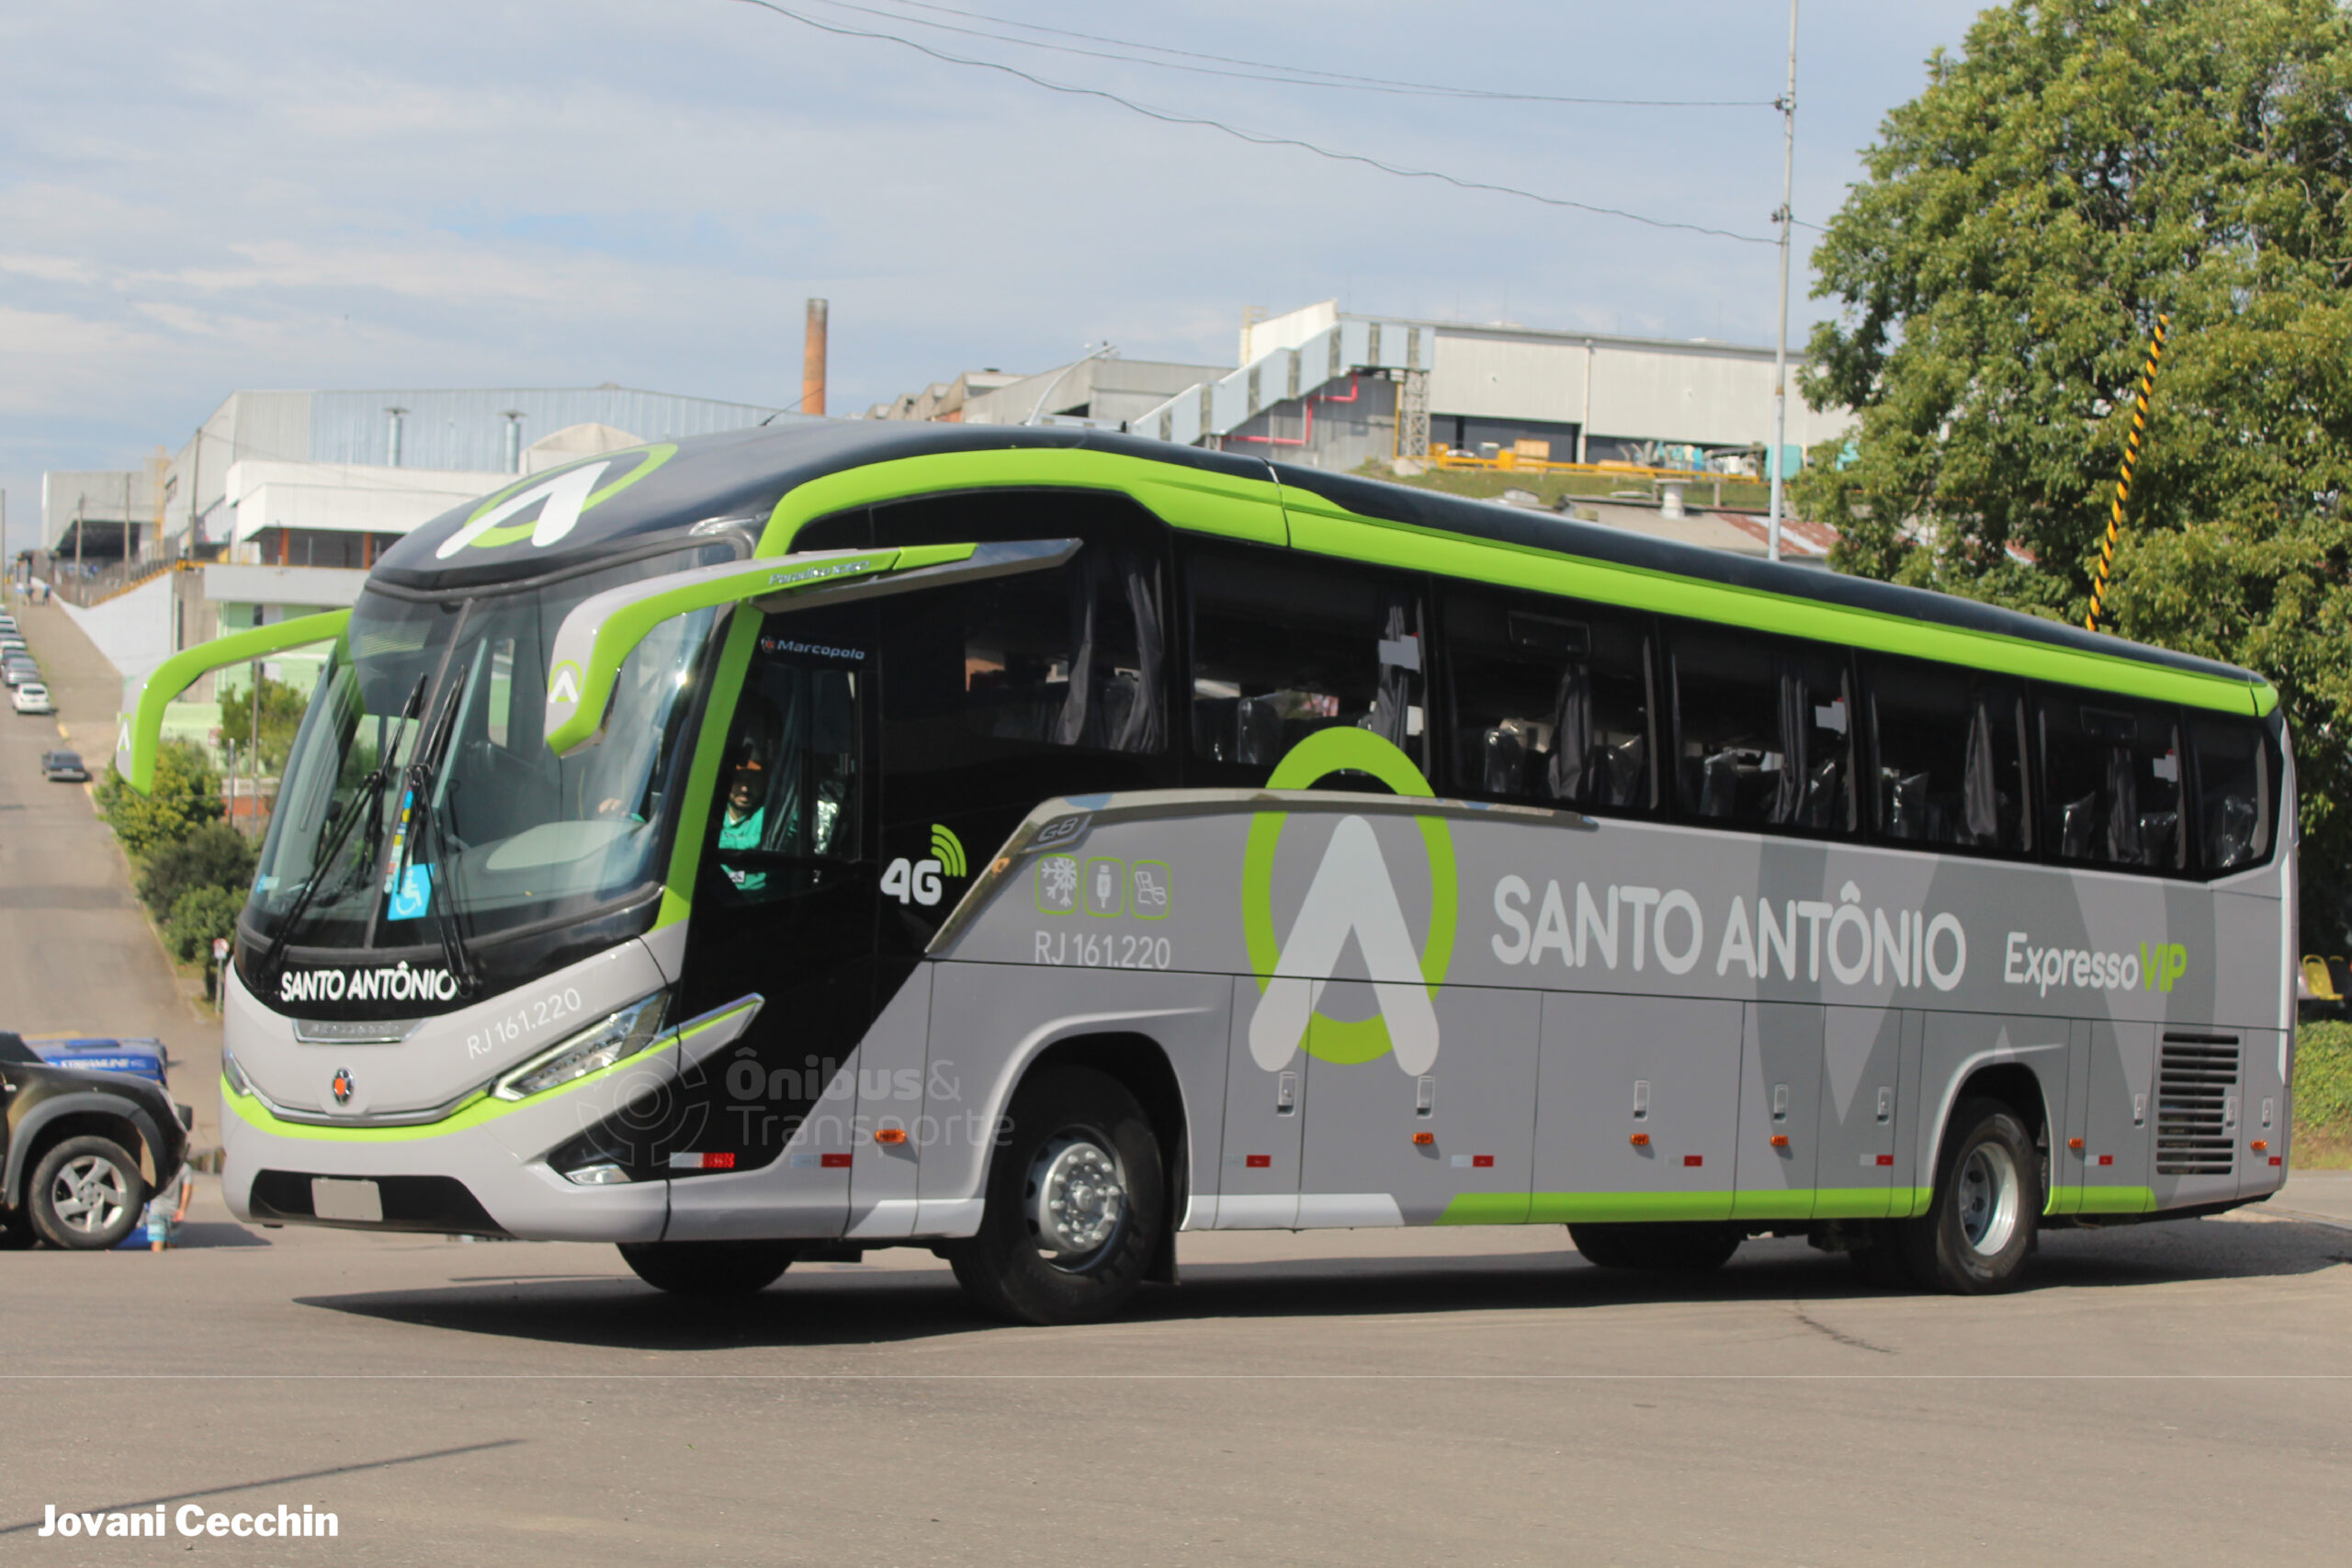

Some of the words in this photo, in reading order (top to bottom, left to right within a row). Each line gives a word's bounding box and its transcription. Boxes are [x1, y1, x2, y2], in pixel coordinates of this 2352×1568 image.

[776, 639, 865, 660] Marcopolo
[880, 857, 943, 906] 4G
[1035, 931, 1065, 964] RJ
[1073, 933, 1171, 970] 161.220
[1491, 874, 1703, 976] SANTO
[1716, 880, 1967, 992] ANTÔNIO
[280, 969, 346, 1002] SANTO
[346, 960, 458, 1001] ANTÔNIO
[466, 1028, 492, 1059] RJ
[494, 987, 582, 1043] 161.220
